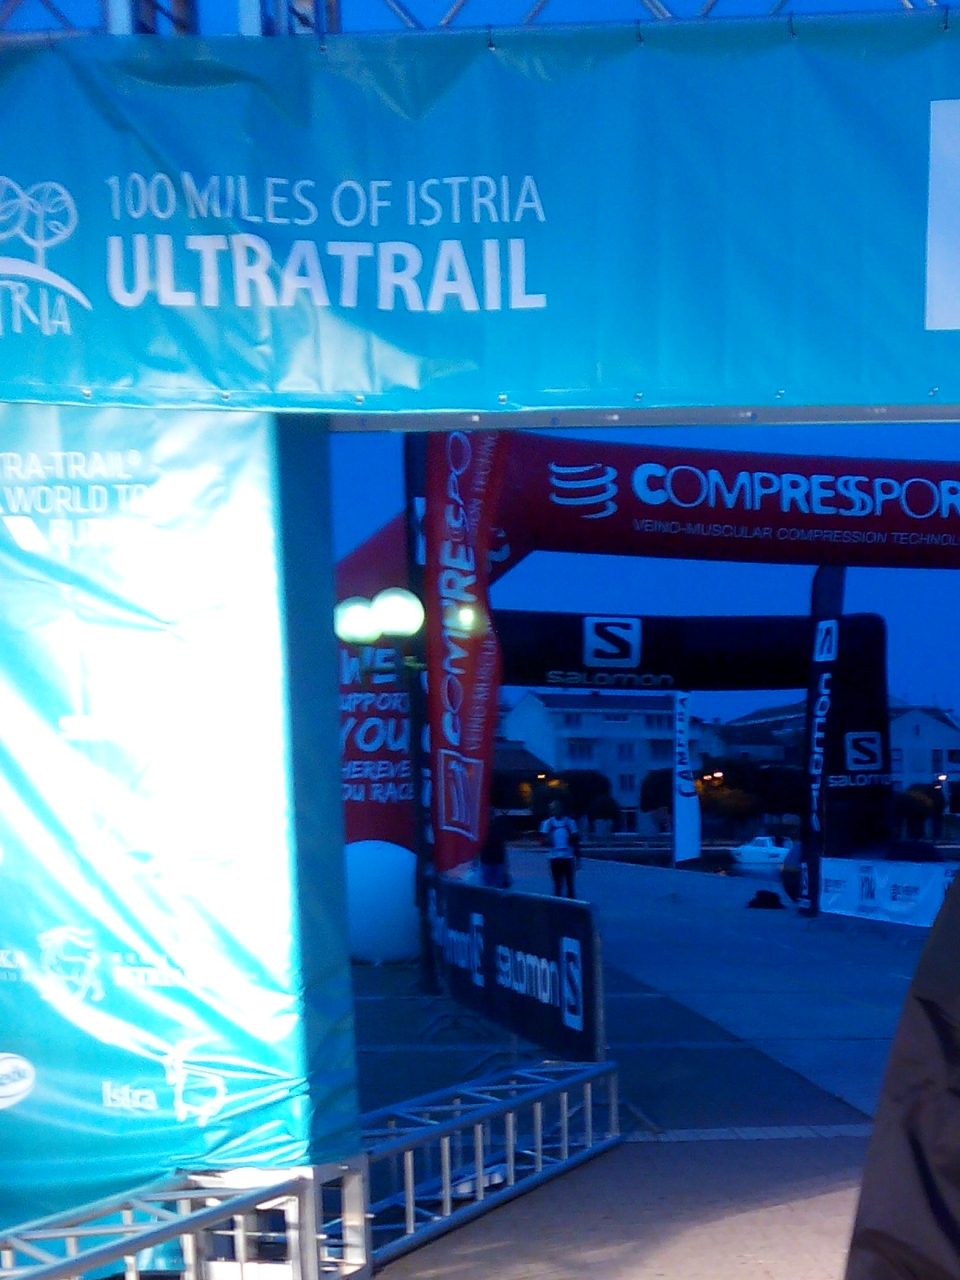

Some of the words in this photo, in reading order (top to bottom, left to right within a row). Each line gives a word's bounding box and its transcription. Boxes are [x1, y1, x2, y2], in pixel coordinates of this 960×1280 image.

[106, 173, 177, 221] 100
[180, 172, 318, 226] MILES
[332, 179, 392, 228] OF
[407, 175, 547, 225] ISTRIA
[106, 233, 548, 314] ULTRATRAIL
[4, 485, 109, 514] WORLD
[776, 527, 886, 545] COMPRESSION
[545, 669, 675, 687] salomon
